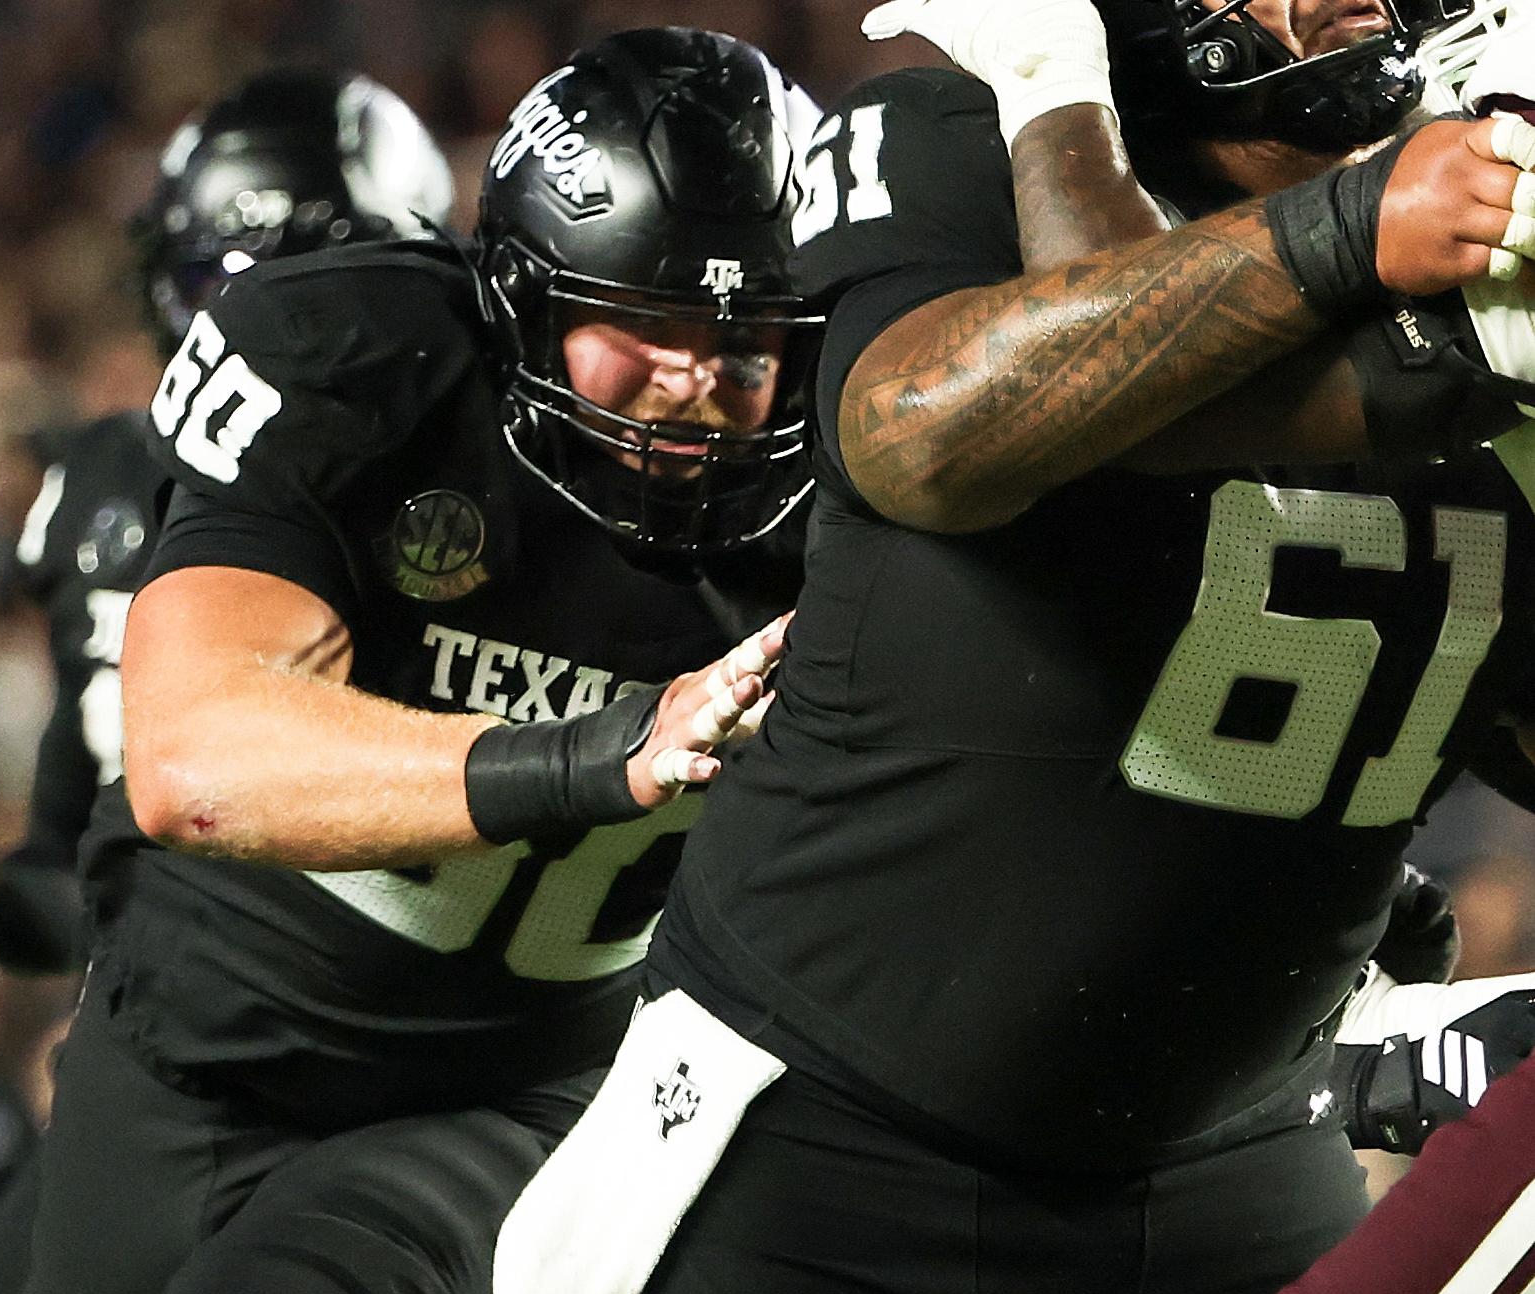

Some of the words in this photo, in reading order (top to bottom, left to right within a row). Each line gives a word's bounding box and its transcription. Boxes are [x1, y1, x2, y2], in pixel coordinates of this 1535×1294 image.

[790, 103, 893, 248] 61
[150, 311, 282, 484] 60
[422, 623, 637, 723] TEXA
[1119, 480, 1508, 827] 61
